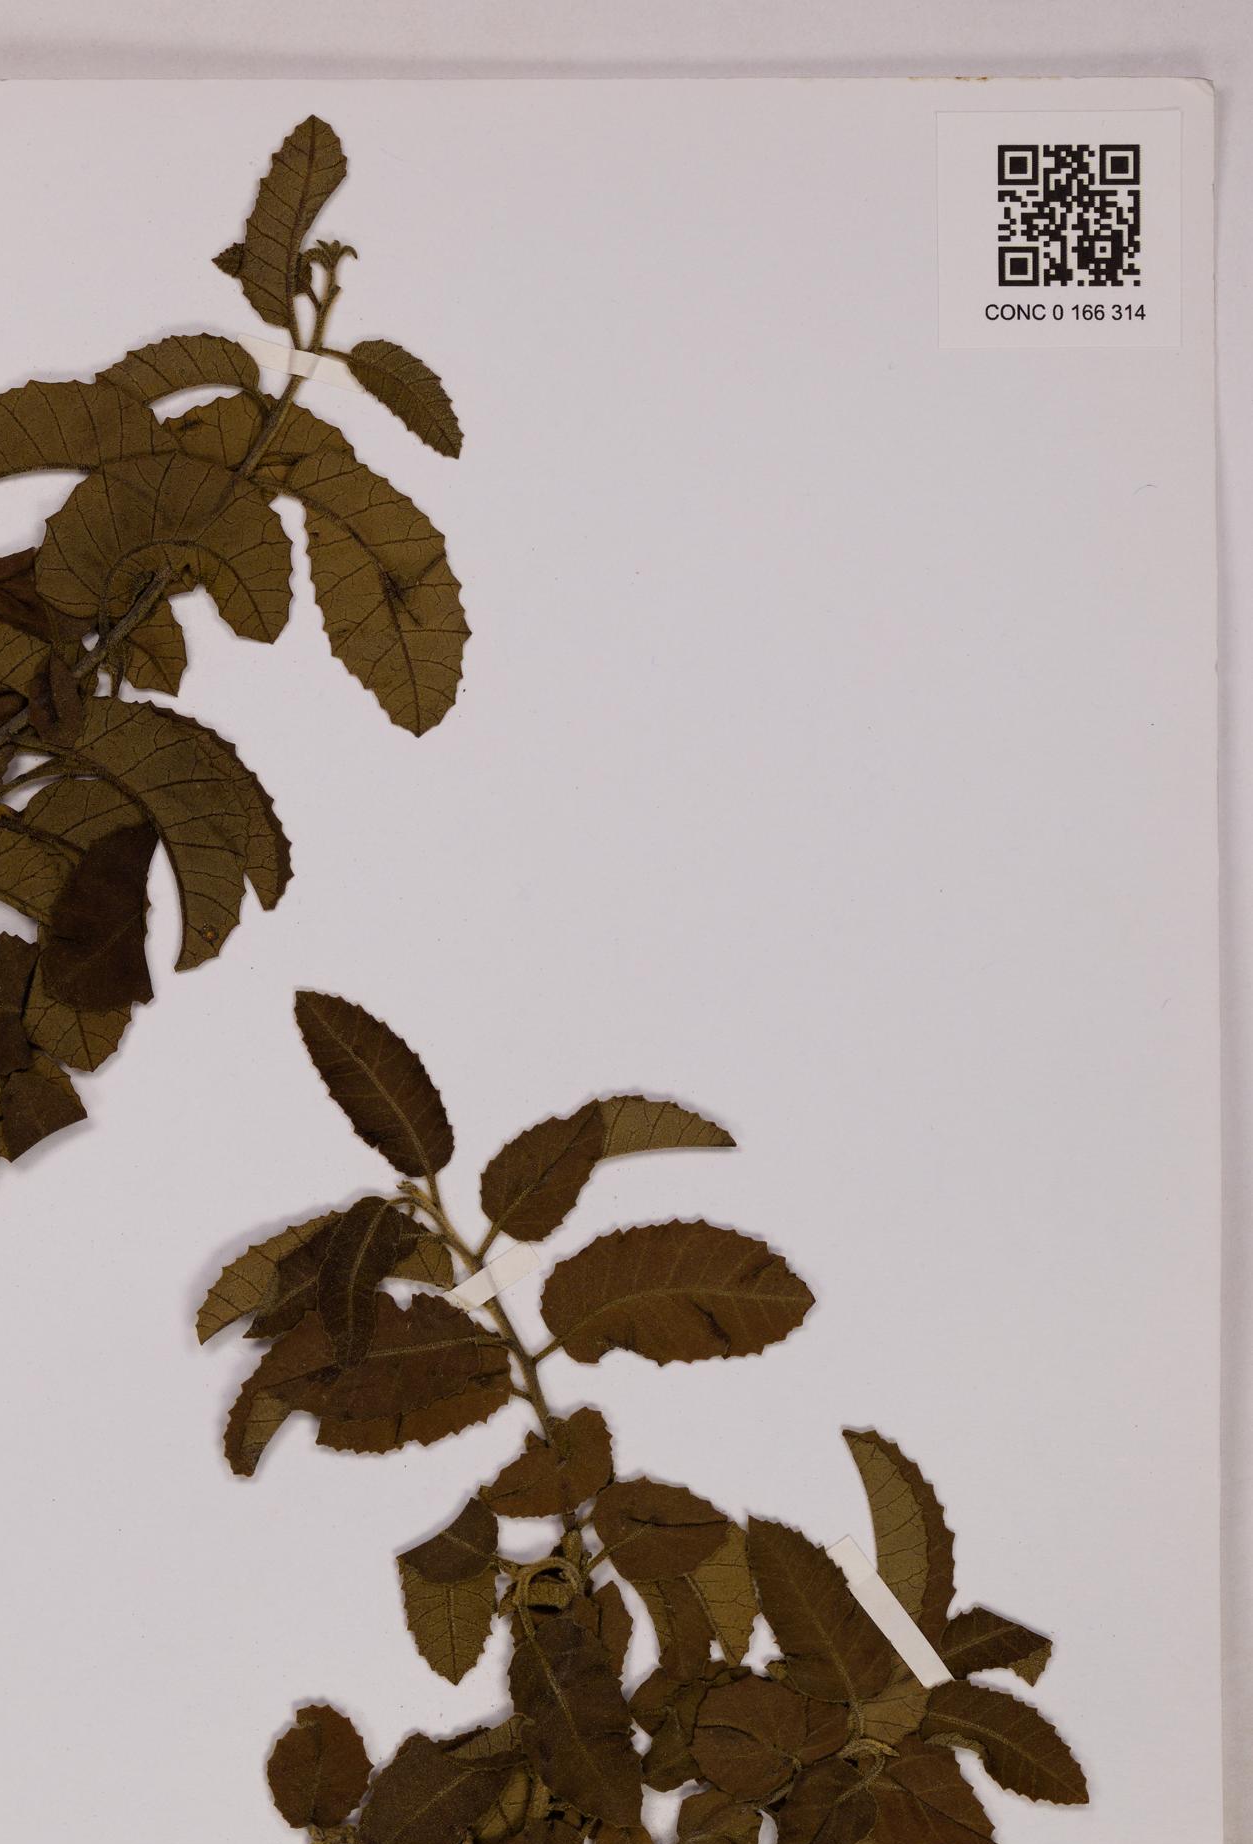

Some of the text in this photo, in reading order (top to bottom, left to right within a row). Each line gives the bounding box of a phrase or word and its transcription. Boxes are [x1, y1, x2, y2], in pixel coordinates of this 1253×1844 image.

[985, 303, 1147, 321] CONC 0 166 314
